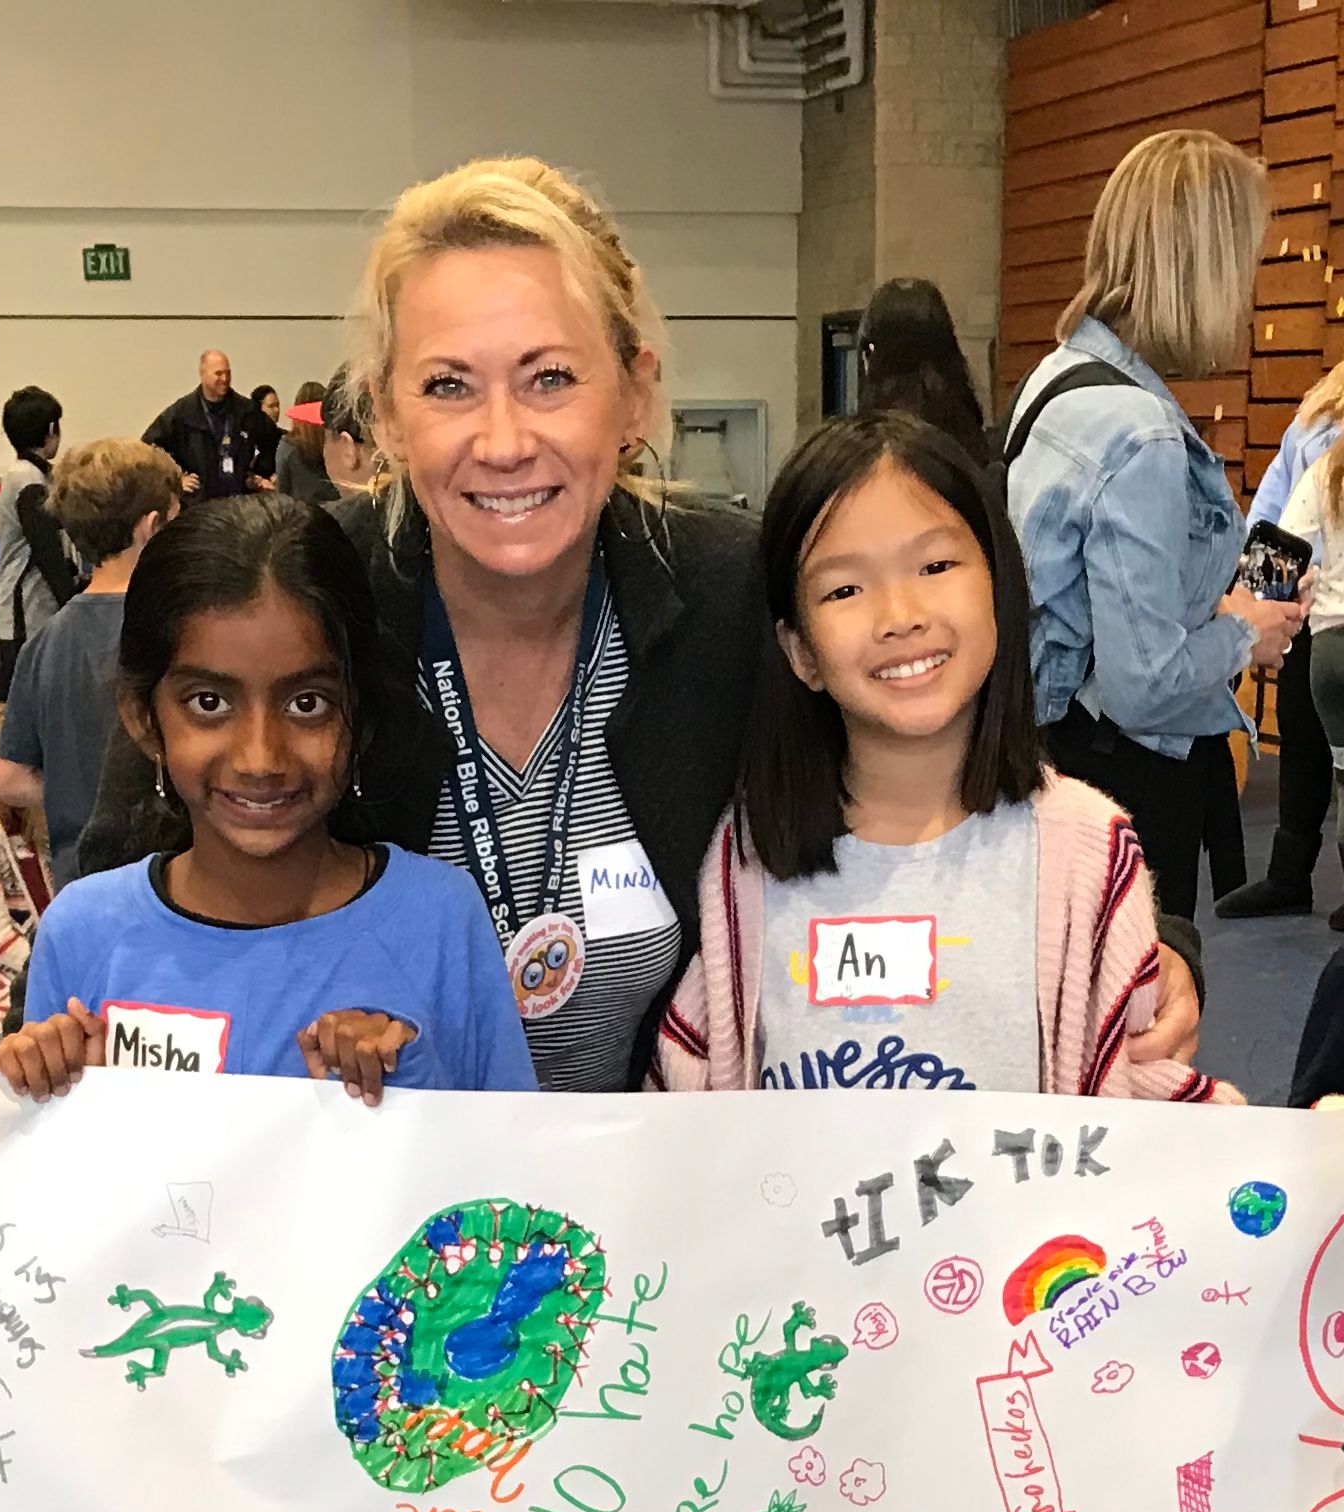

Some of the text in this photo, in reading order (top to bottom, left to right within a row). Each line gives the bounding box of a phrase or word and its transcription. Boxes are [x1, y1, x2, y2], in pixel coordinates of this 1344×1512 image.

[86, 252, 125, 275] EXIT
[570, 662, 586, 745] School
[433, 659, 515, 952] National Blue Ribbon Sch
[552, 751, 578, 833] Ribbon
[548, 838, 563, 891] Blue
[837, 933, 886, 981] An
[112, 1021, 200, 1073] Misha
[991, 1124, 1112, 1184] TOK
[556, 1261, 669, 1422] hate
